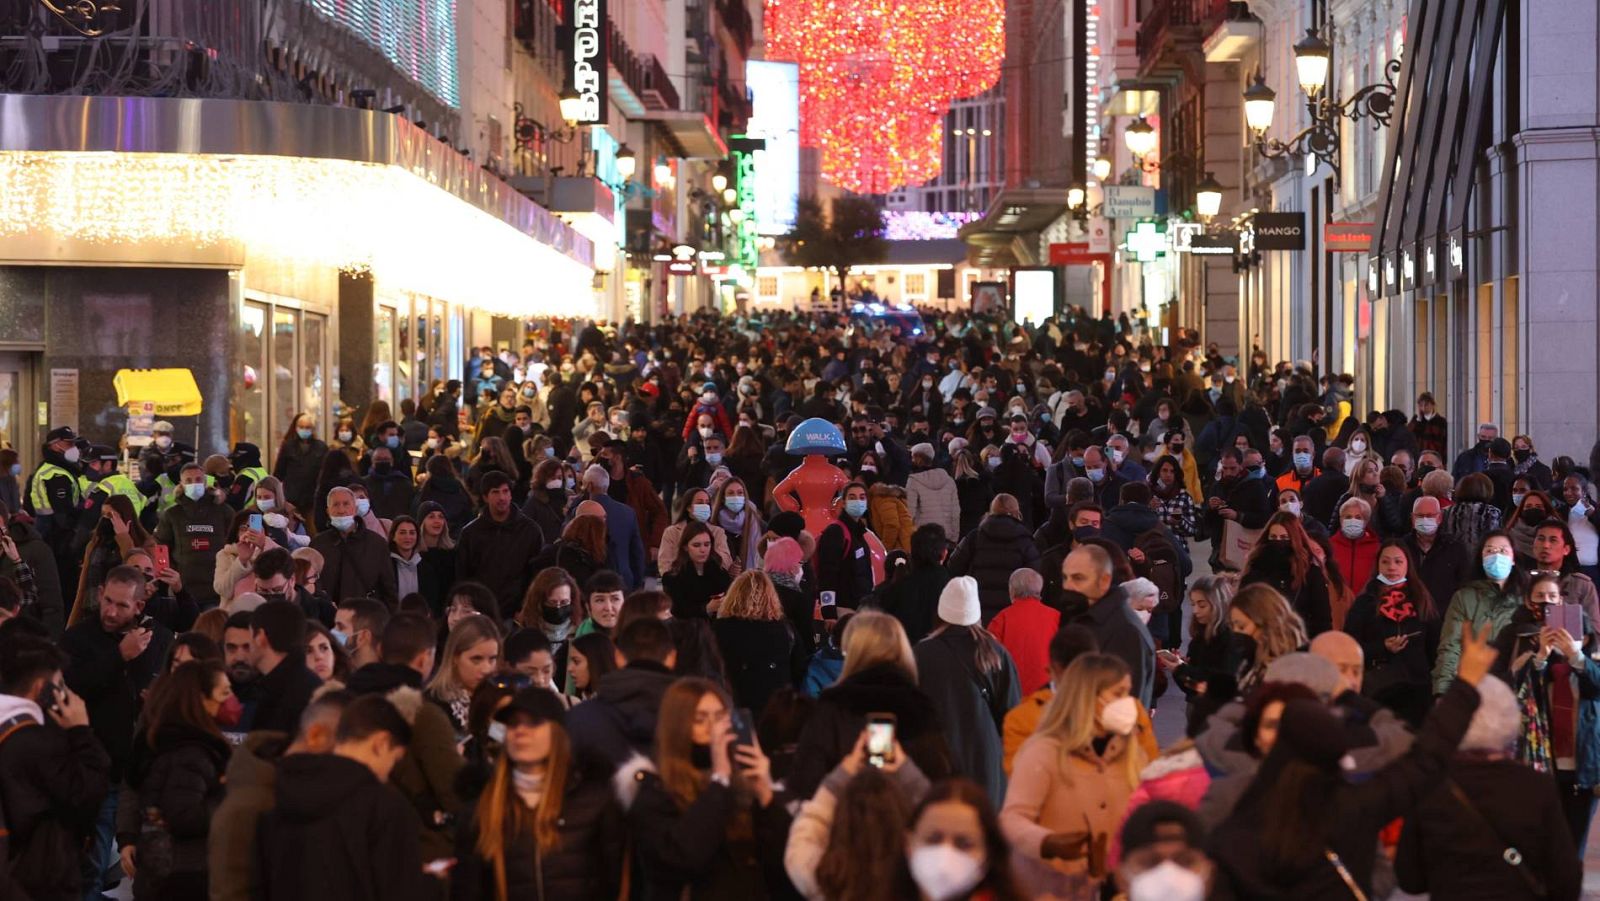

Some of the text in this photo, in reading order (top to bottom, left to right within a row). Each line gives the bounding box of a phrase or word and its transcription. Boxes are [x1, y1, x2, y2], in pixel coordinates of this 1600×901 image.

[1108, 196, 1151, 207] Danubio
[1258, 226, 1301, 236] MANGO
[806, 432, 830, 441] WALK
